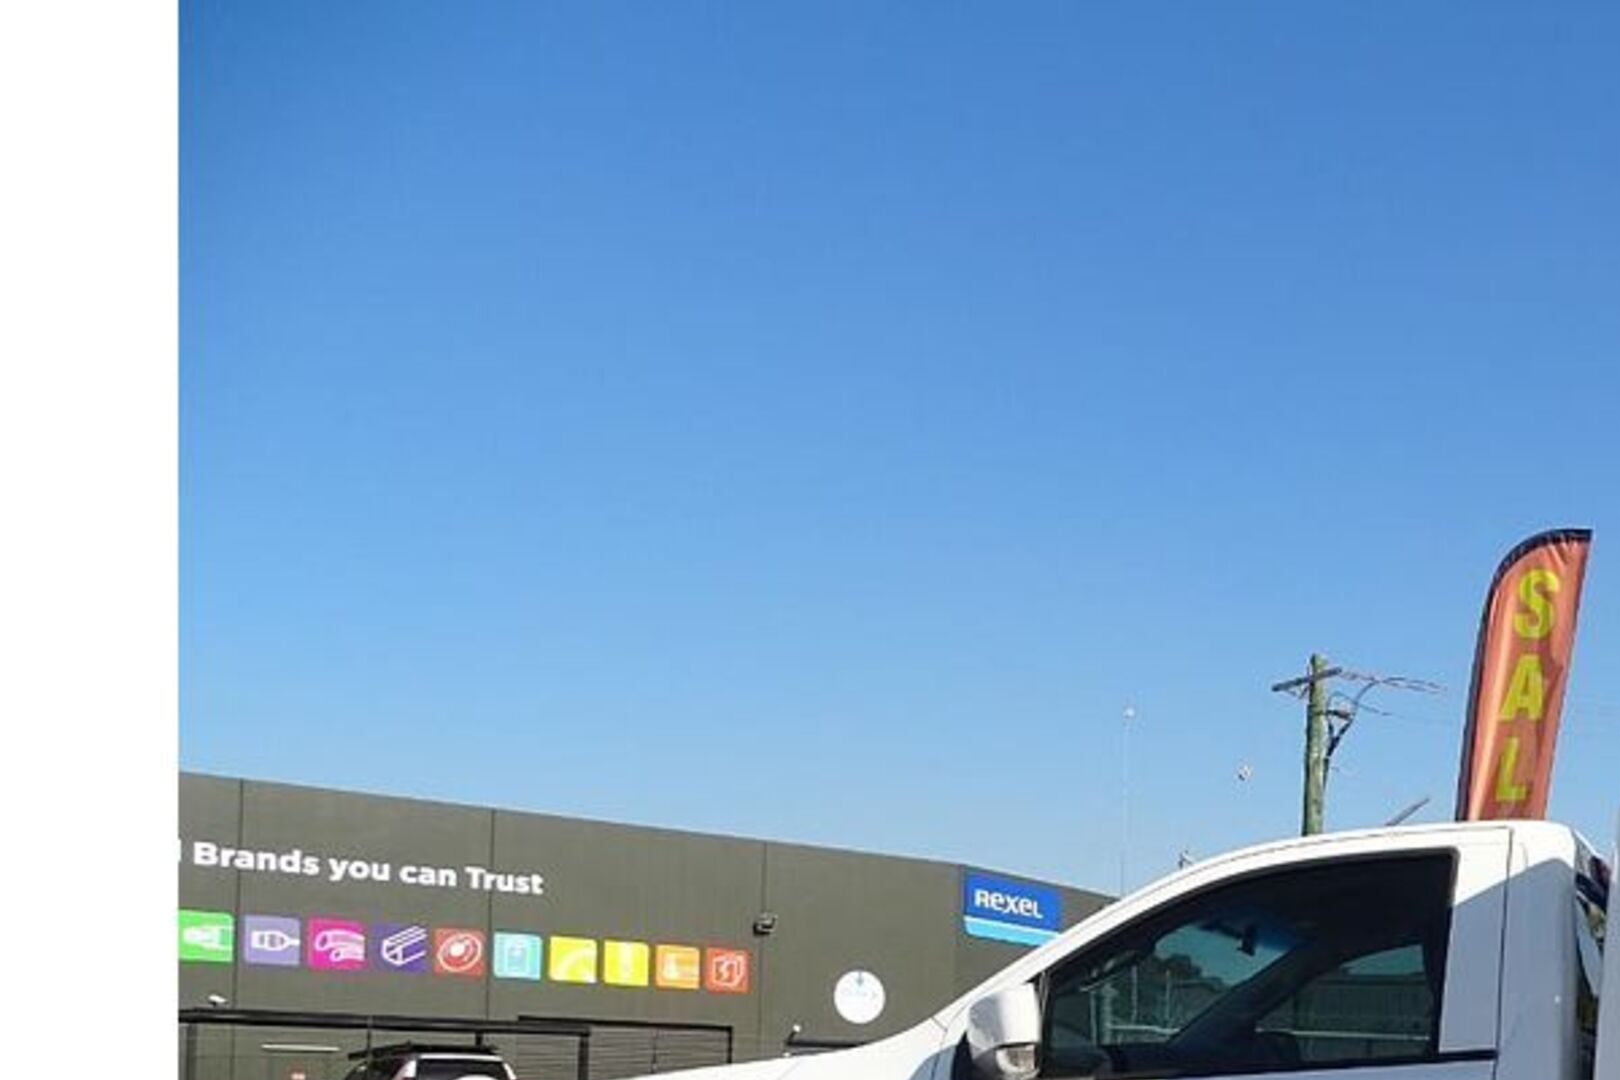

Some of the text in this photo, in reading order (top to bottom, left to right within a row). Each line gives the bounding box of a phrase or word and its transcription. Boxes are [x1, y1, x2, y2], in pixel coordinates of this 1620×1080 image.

[1494, 568, 1560, 802] SAL
[193, 841, 321, 876] Brands
[327, 857, 391, 881] you
[399, 864, 458, 887] can
[464, 866, 544, 895] Trust
